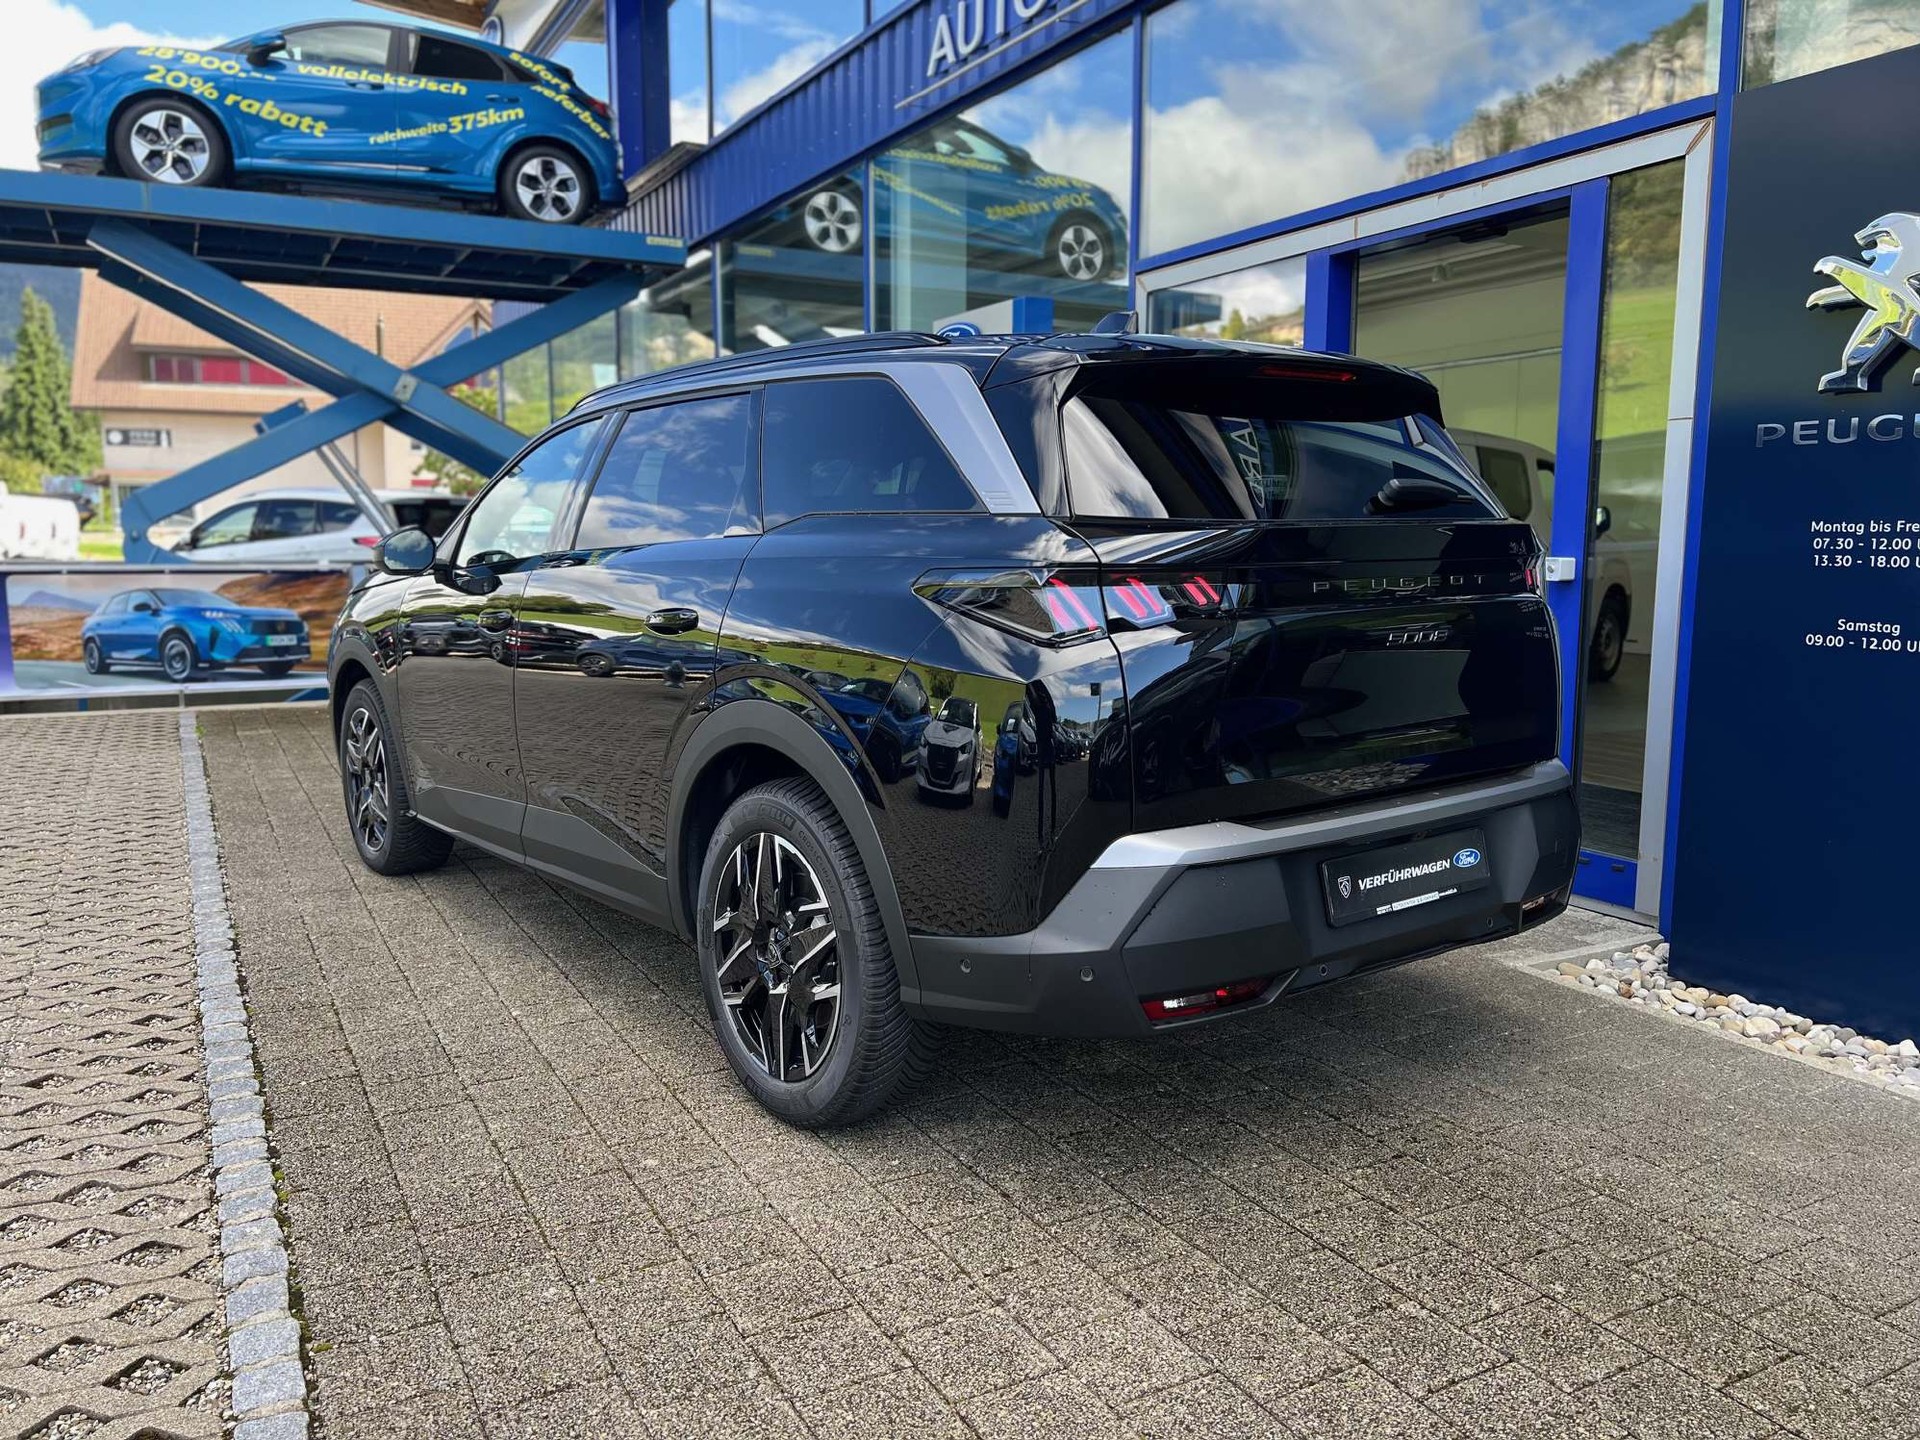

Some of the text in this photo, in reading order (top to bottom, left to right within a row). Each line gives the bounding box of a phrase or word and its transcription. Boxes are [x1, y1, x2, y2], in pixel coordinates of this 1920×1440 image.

[298, 64, 467, 95] vollelektrisch
[143, 64, 328, 138] 20% rabatt
[369, 107, 525, 145] reichweite 375km
[1755, 413, 1920, 447] PEUG
[1811, 520, 1865, 535] Montag
[1869, 520, 1891, 532] bis
[1813, 538, 1854, 549] 07.30
[1871, 538, 1912, 550] 12.00
[1814, 555, 1852, 567] 13.30
[1870, 555, 1910, 568] 18.00
[1313, 574, 1486, 593] PEUGEOT
[1837, 618, 1901, 636] Samstag
[1805, 633, 1844, 647] 09.00
[1862, 637, 1902, 651] 12.00
[1906, 640, 1920, 652] U
[1358, 859, 1450, 891] VERFÜHRWAGEN
